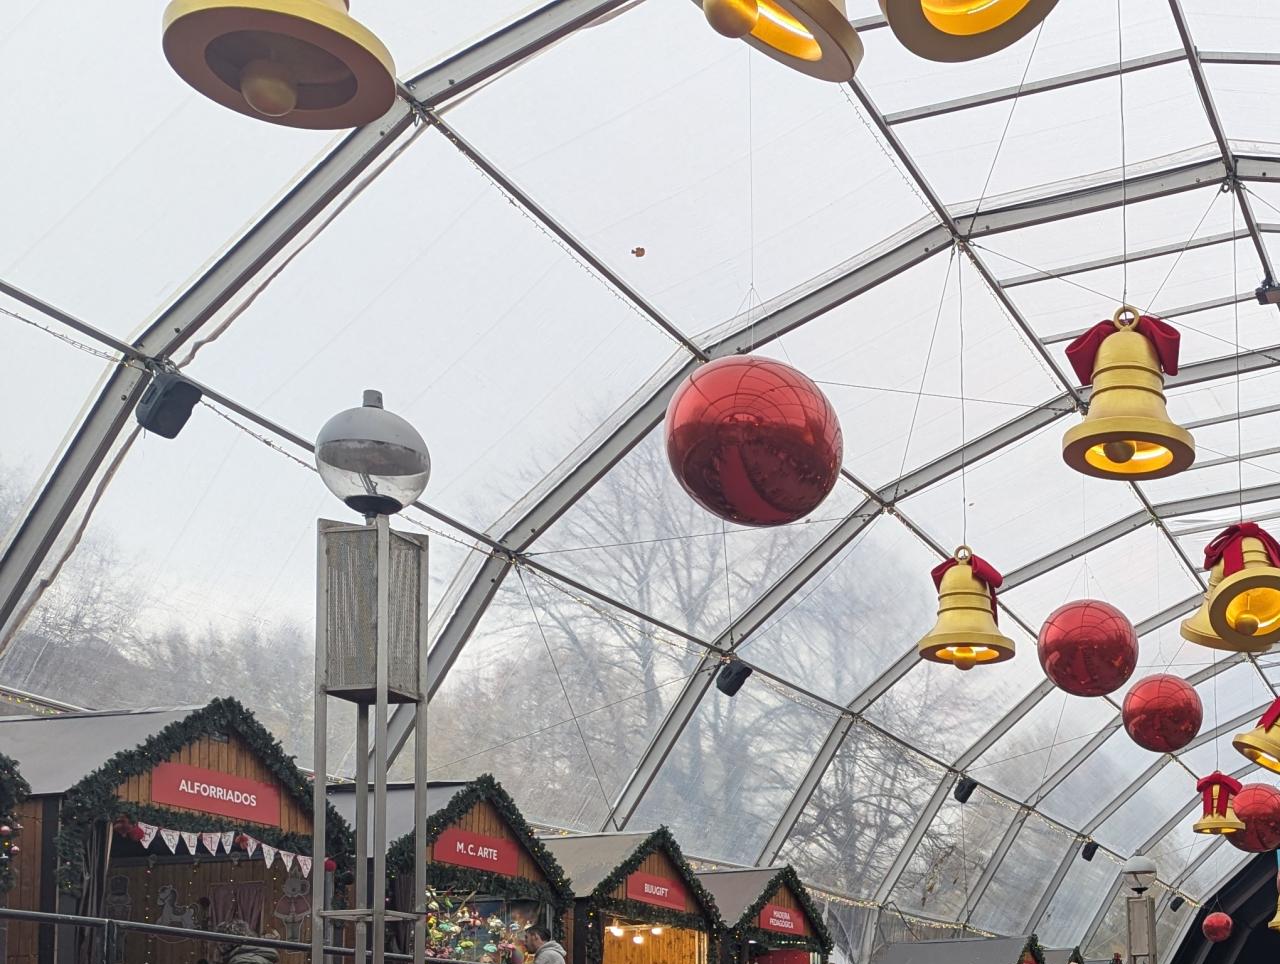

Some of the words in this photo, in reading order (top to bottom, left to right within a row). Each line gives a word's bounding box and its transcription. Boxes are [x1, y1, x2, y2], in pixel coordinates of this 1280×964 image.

[178, 778, 257, 807] ALFORRIADOS
[456, 841, 467, 854] M.
[467, 844, 476, 856] C.
[477, 846, 498, 861] ARTE
